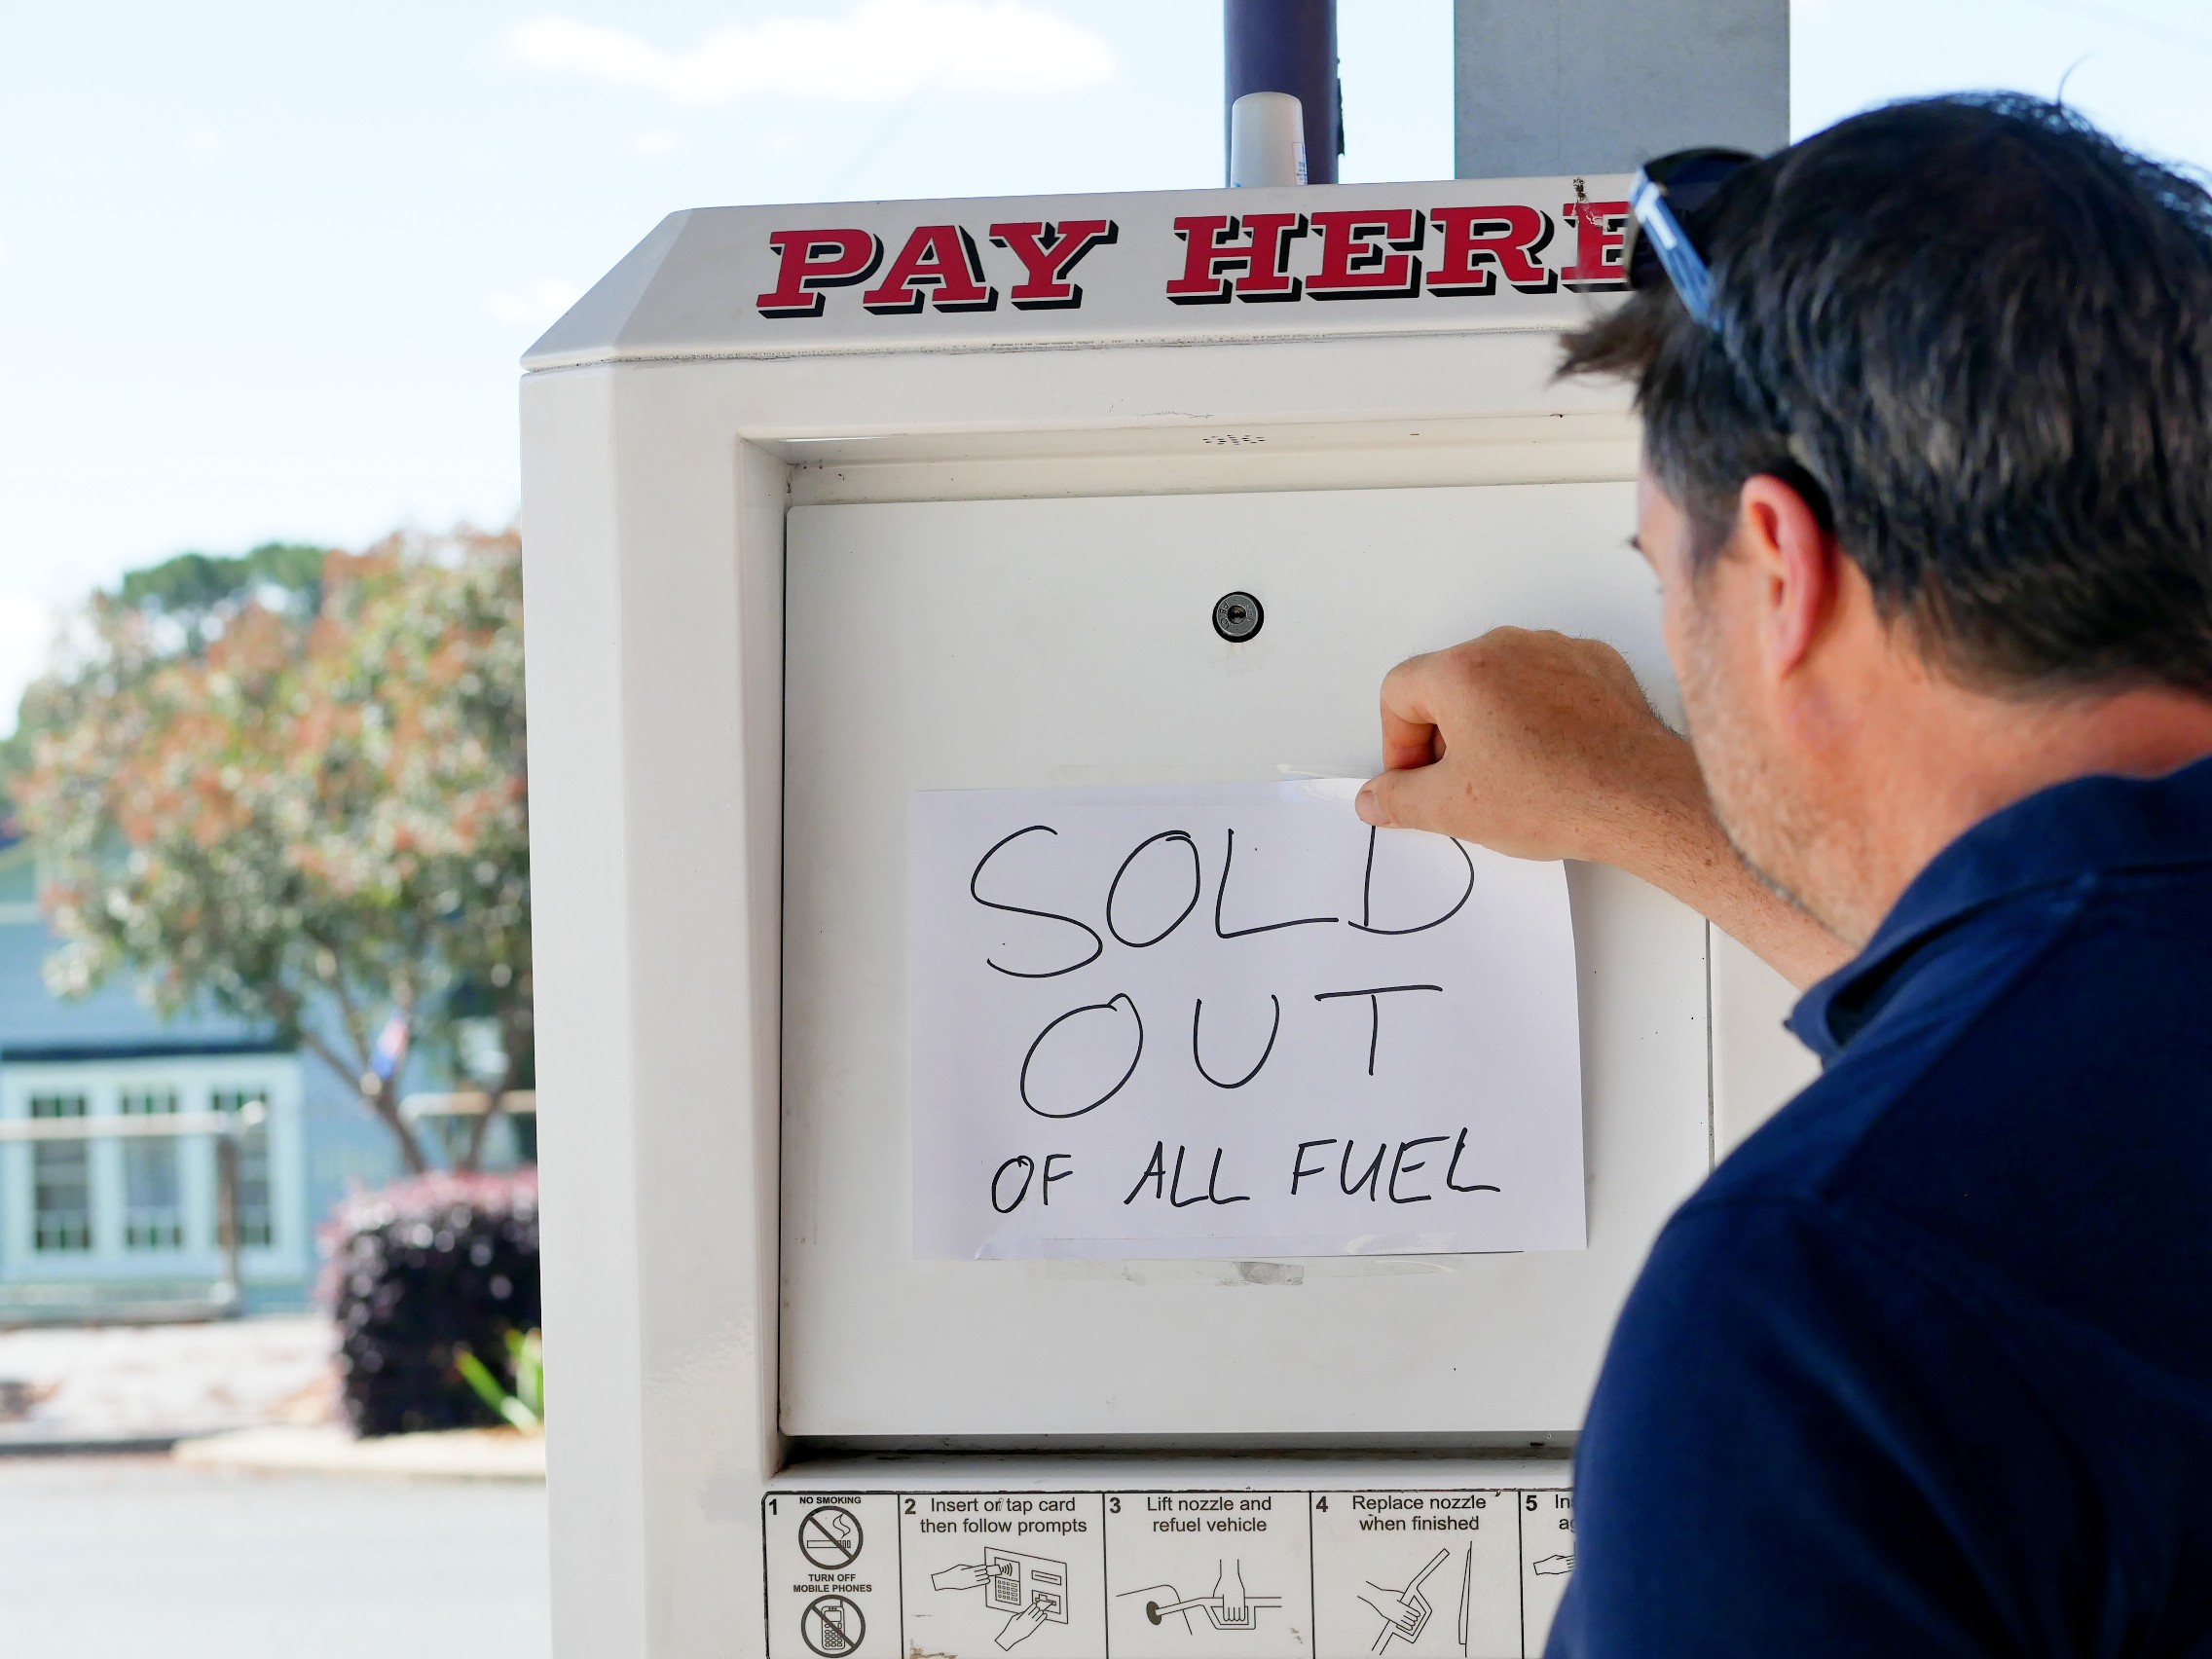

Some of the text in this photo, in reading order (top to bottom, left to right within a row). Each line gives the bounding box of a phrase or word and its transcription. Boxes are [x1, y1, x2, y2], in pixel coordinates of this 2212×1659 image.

[756, 220, 1119, 319] PAY
[971, 826, 1474, 977] SOLD
[1020, 985, 1443, 1118] OUT
[992, 1127, 1500, 1213] OF ALL FUEL
[768, 1499, 779, 1516] 1
[816, 1495, 862, 1504] SMOKING
[904, 1498, 916, 1514] 2
[932, 1497, 1075, 1515] Insert or tap card
[1110, 1497, 1121, 1513] 3
[1148, 1496, 1271, 1511] Lift nozzle and
[1316, 1496, 1328, 1512] 4
[1353, 1495, 1486, 1514] Replace nozzle
[1526, 1495, 1537, 1511] 5
[920, 1519, 1087, 1535] then follow prompts
[1154, 1518, 1267, 1531] refuel vehicle
[1359, 1516, 1479, 1531] when finished
[808, 1573, 857, 1583] TURN OFF
